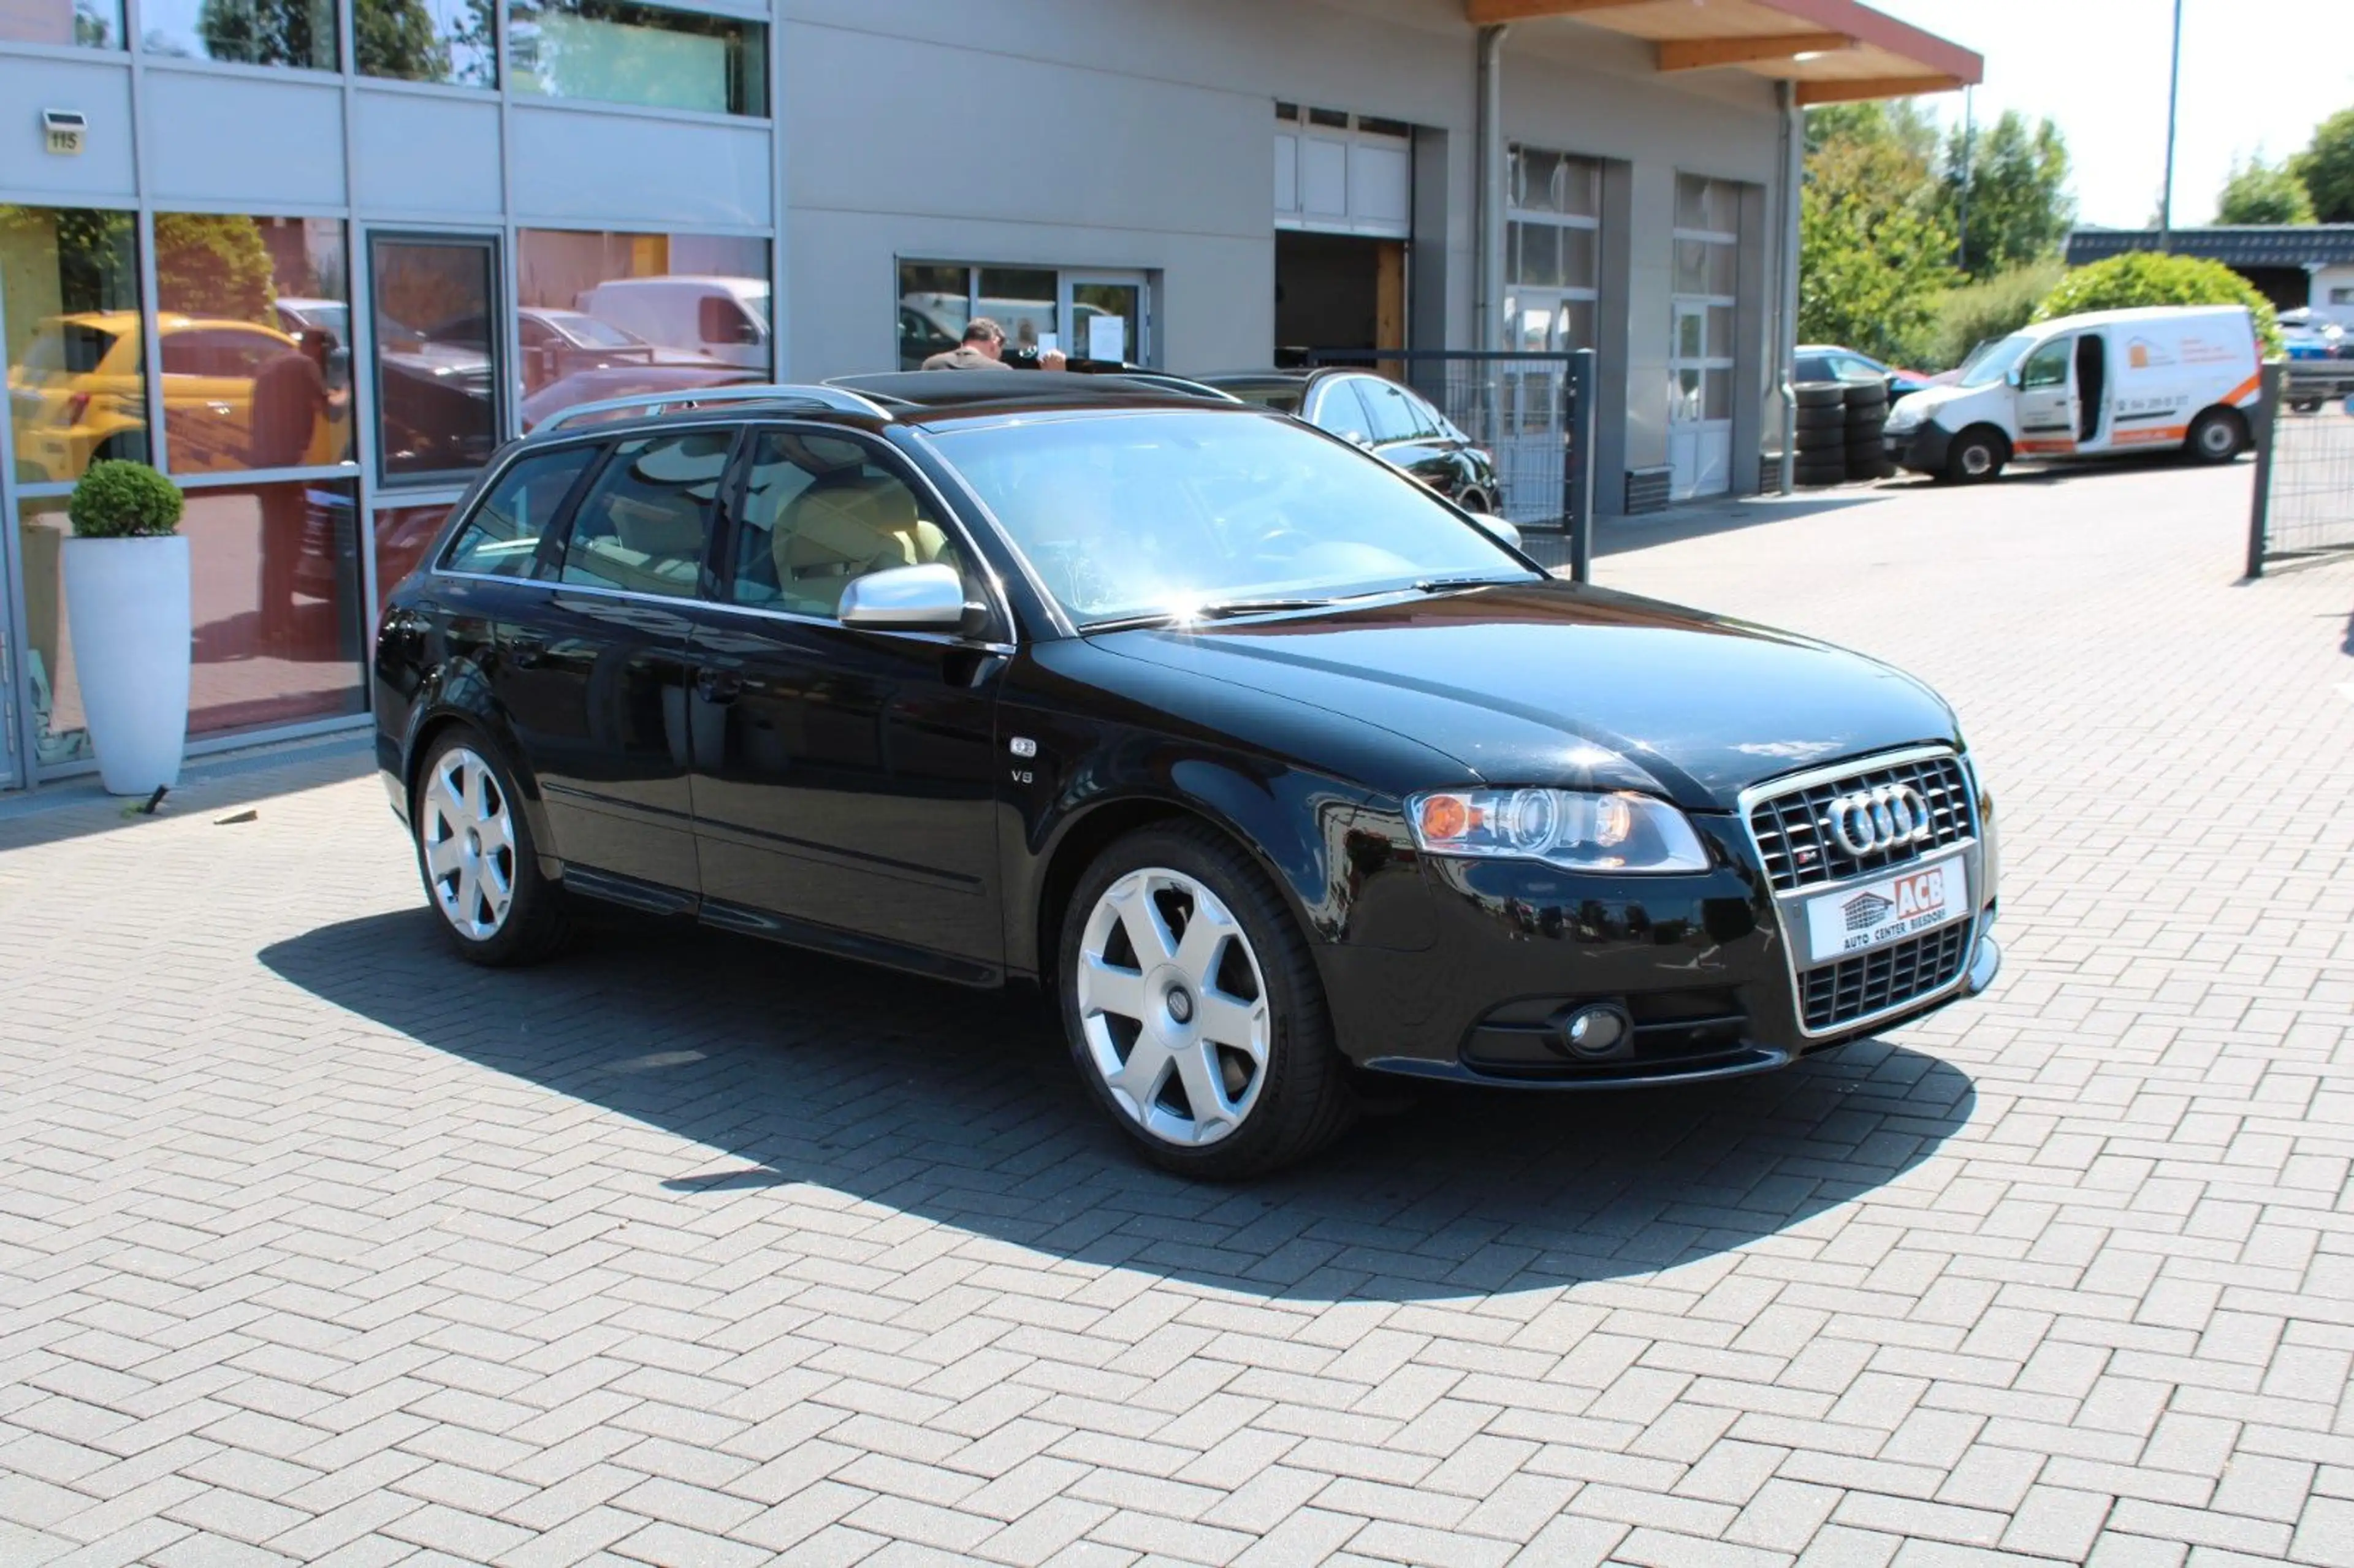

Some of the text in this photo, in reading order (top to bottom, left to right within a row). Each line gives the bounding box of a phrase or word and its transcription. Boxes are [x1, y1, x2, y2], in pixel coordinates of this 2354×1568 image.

[51, 131, 78, 150] 115
[1011, 771, 1032, 783] V8
[1898, 870, 1944, 918] ACB
[1844, 933, 1870, 950] AUTO
[1874, 922, 1906, 941] CENTER
